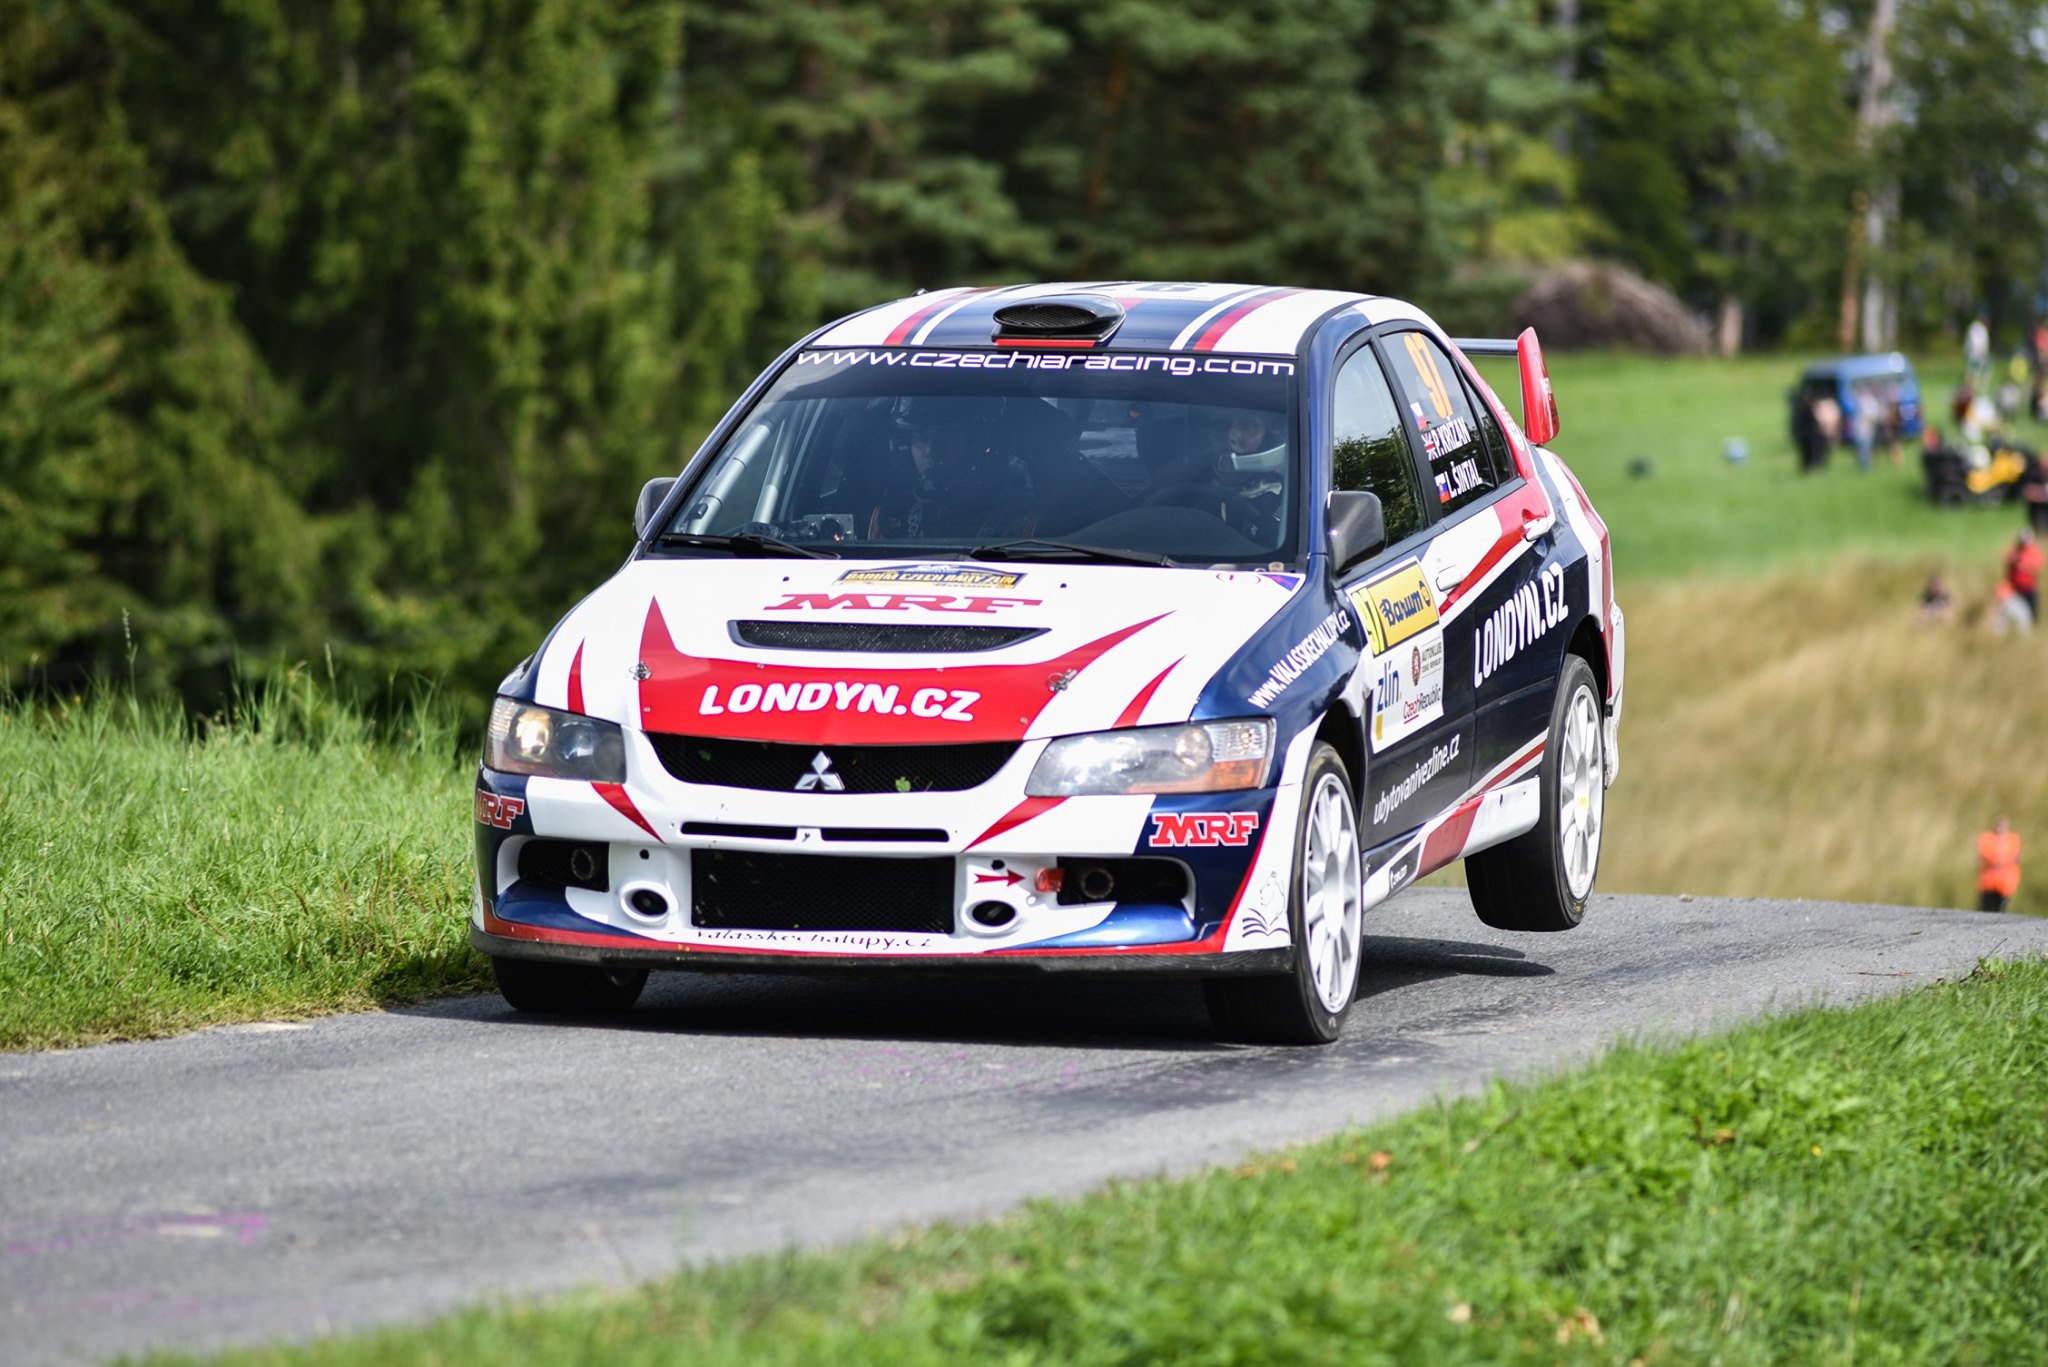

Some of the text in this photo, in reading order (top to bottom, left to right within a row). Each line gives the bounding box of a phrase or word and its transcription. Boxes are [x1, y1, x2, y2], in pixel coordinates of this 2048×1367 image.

[797, 351, 1295, 376] www.czechiaracing.com
[764, 593, 1043, 613] MRF
[1379, 590, 1424, 627] Barum
[1474, 561, 1569, 689] LONDYN.CZ
[699, 683, 981, 723] LONDYN.CZ
[1373, 733, 1461, 826] ubytovanivezline.cz
[1149, 812, 1259, 847] MRF
